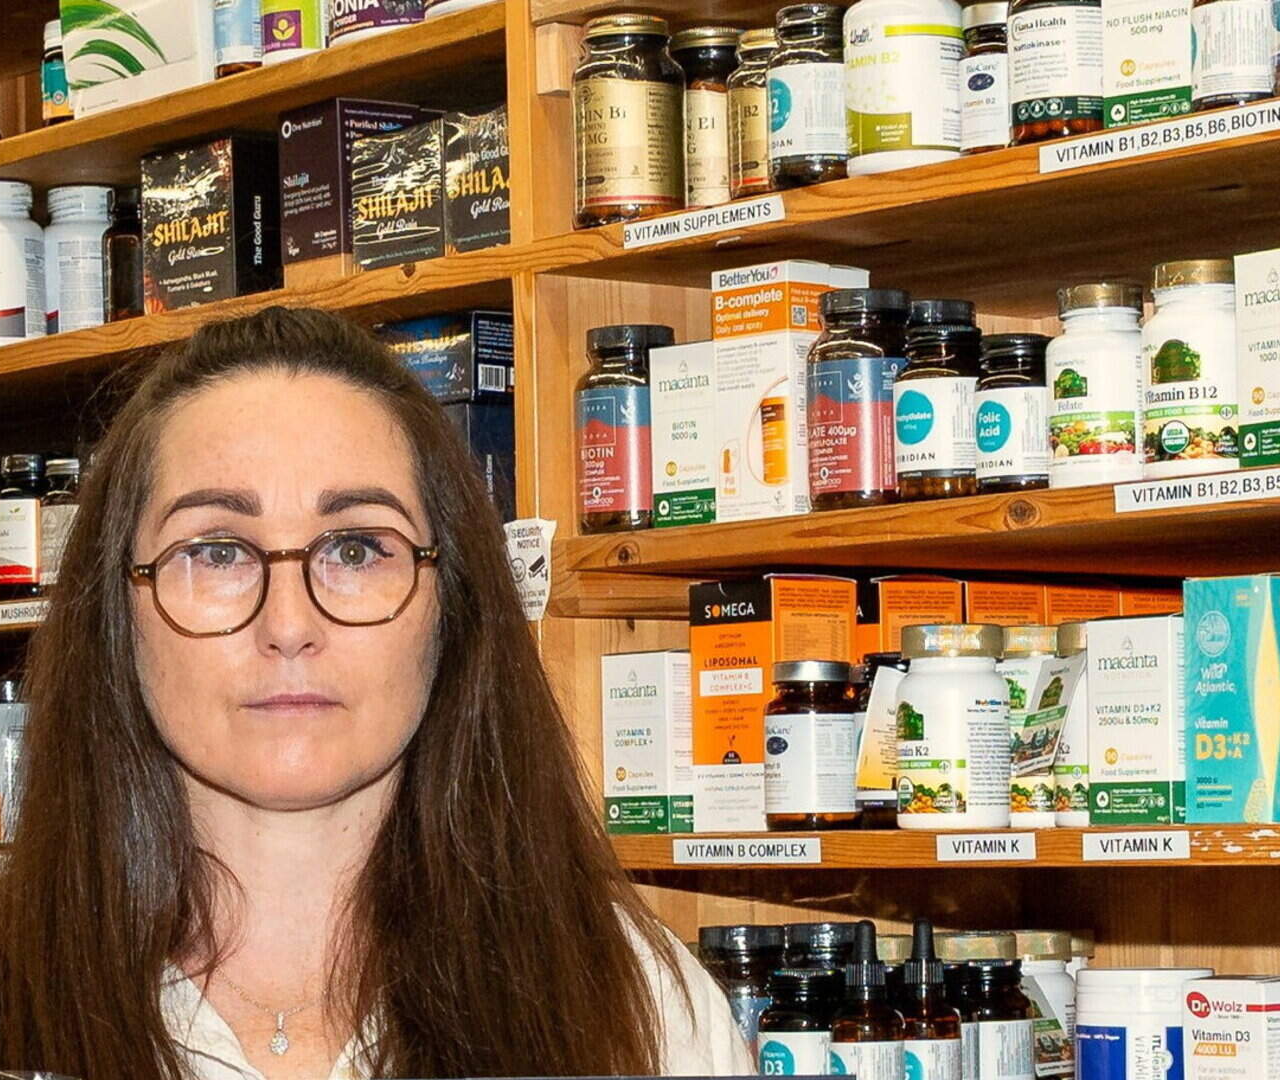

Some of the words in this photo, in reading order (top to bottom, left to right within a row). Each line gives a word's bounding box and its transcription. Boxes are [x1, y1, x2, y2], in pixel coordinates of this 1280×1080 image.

[1056, 142, 1114, 163] VITAMIN
[153, 212, 228, 247] SHILAJIT
[624, 229, 631, 243] B
[634, 220, 681, 241] VITAMIN
[684, 202, 772, 232] SUPPLEMENTS
[718, 268, 770, 288] BetterYou
[714, 289, 783, 310] B-complete
[978, 412, 1001, 425] Folic
[980, 426, 1000, 439] Acid
[1132, 484, 1192, 504] VITAMIN
[703, 656, 758, 667] LIPOSOMAL
[1097, 653, 1158, 671] macánta
[609, 683, 657, 699] macánta
[686, 843, 734, 860] VITAMIN
[736, 843, 744, 857] B
[747, 841, 807, 858] COMPLEX
[952, 840, 1007, 854] VITAMIN
[1010, 839, 1020, 853] K
[1099, 838, 1160, 854] VITAMIN
[1163, 837, 1173, 852] K
[1212, 1000, 1243, 1014] Wolz
[1191, 1029, 1226, 1043] Vitamin
[1229, 1030, 1250, 1042] D3
